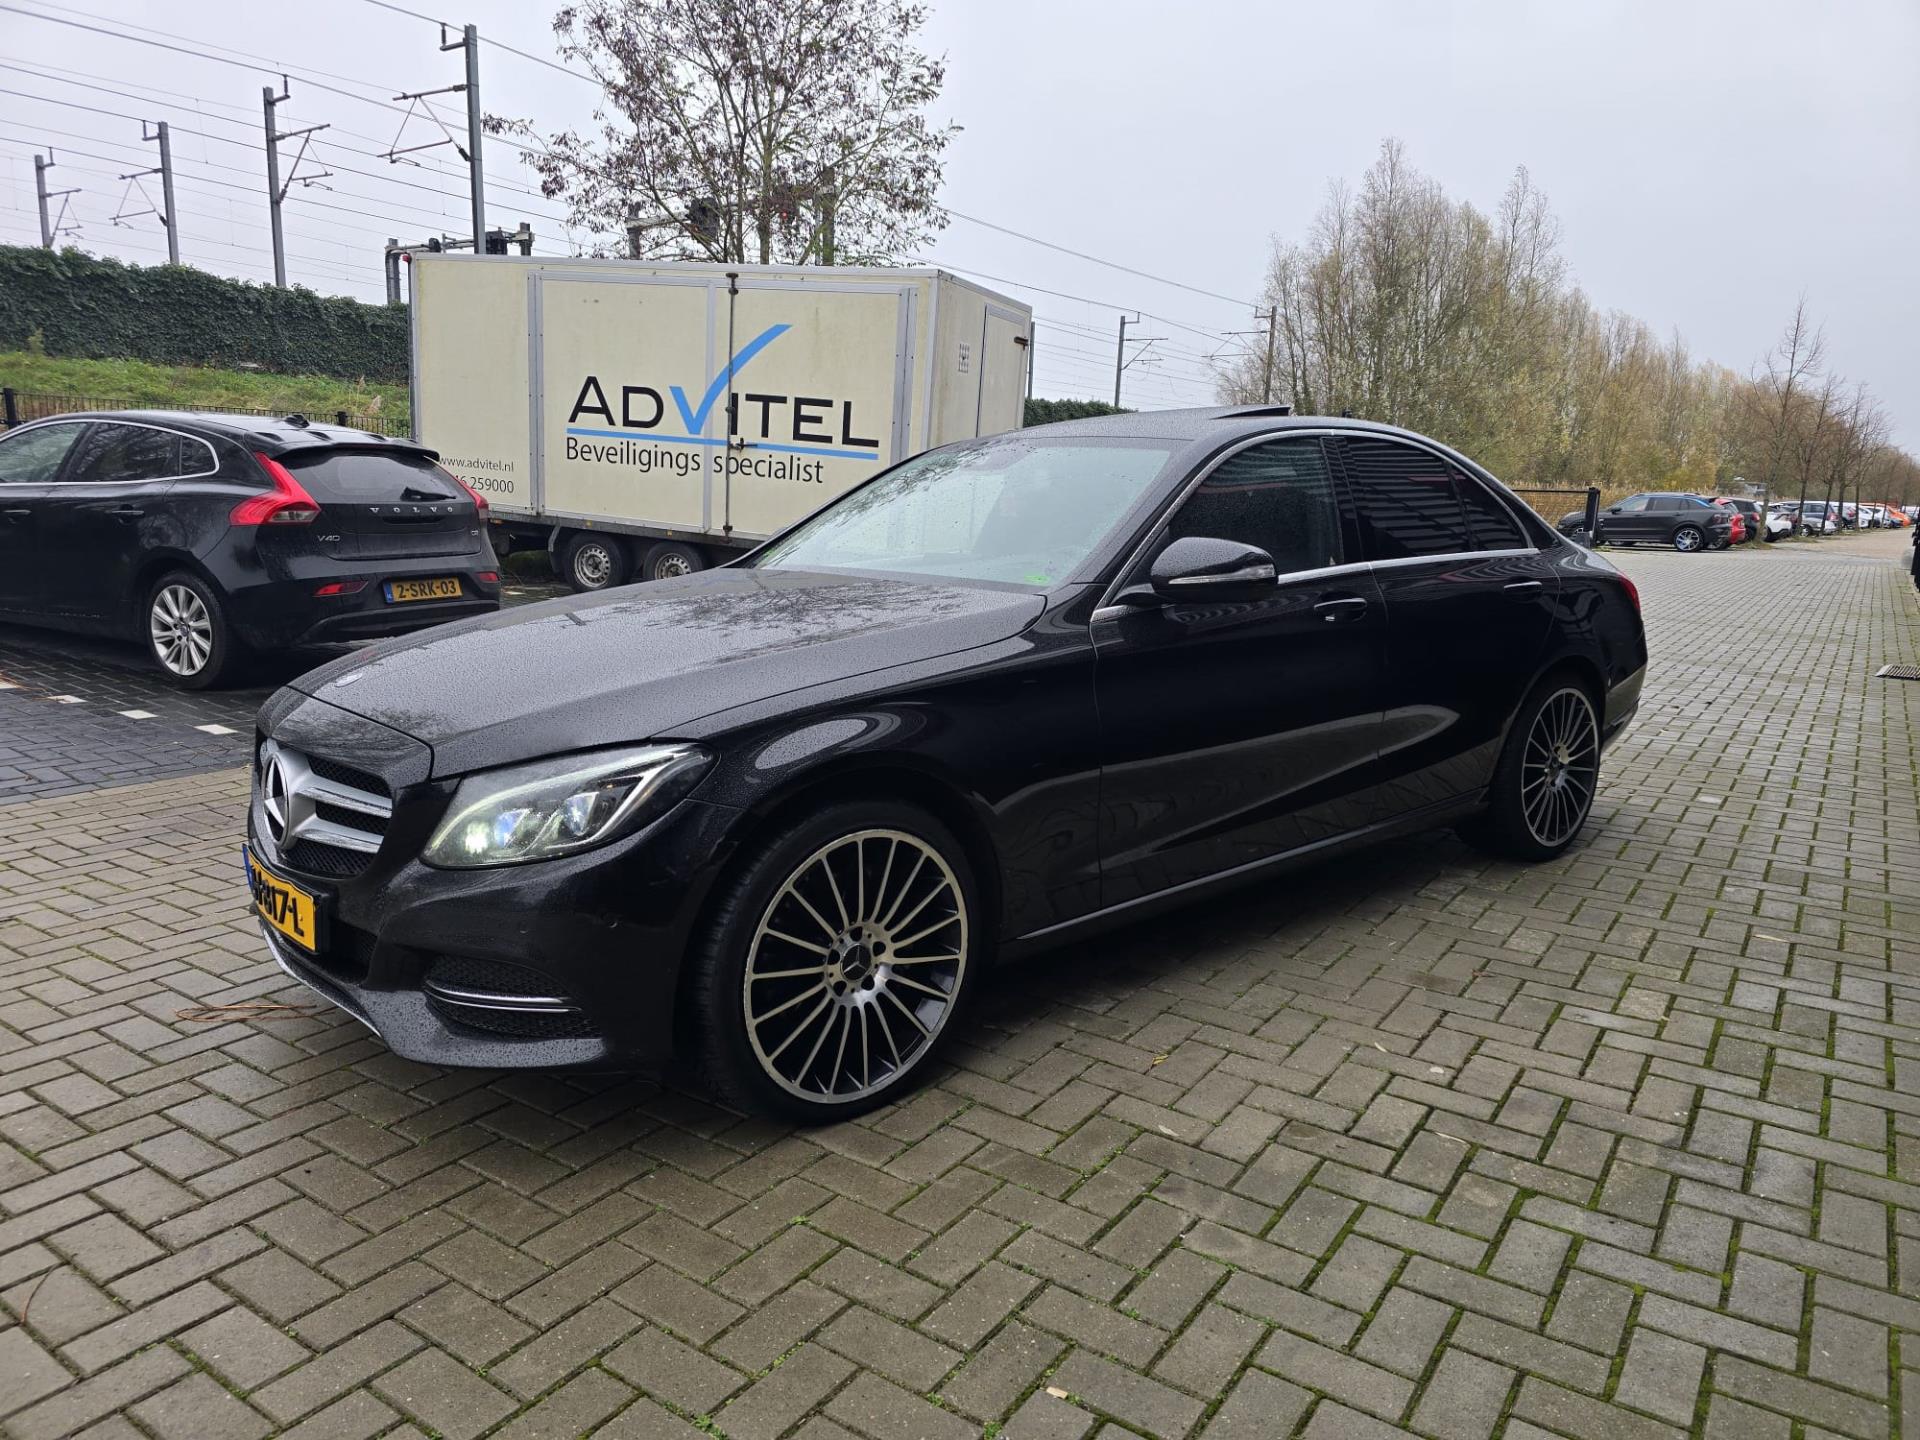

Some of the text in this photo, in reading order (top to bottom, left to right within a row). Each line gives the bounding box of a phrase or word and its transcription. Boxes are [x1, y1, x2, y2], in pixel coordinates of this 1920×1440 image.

[568, 324, 879, 448] ADVITEL
[440, 457, 514, 472] www.advitel.nl
[566, 437, 823, 483] Beveiligings specialist
[470, 476, 514, 493] 259000
[317, 534, 341, 542] V40
[396, 580, 457, 599] 2-SRK-03
